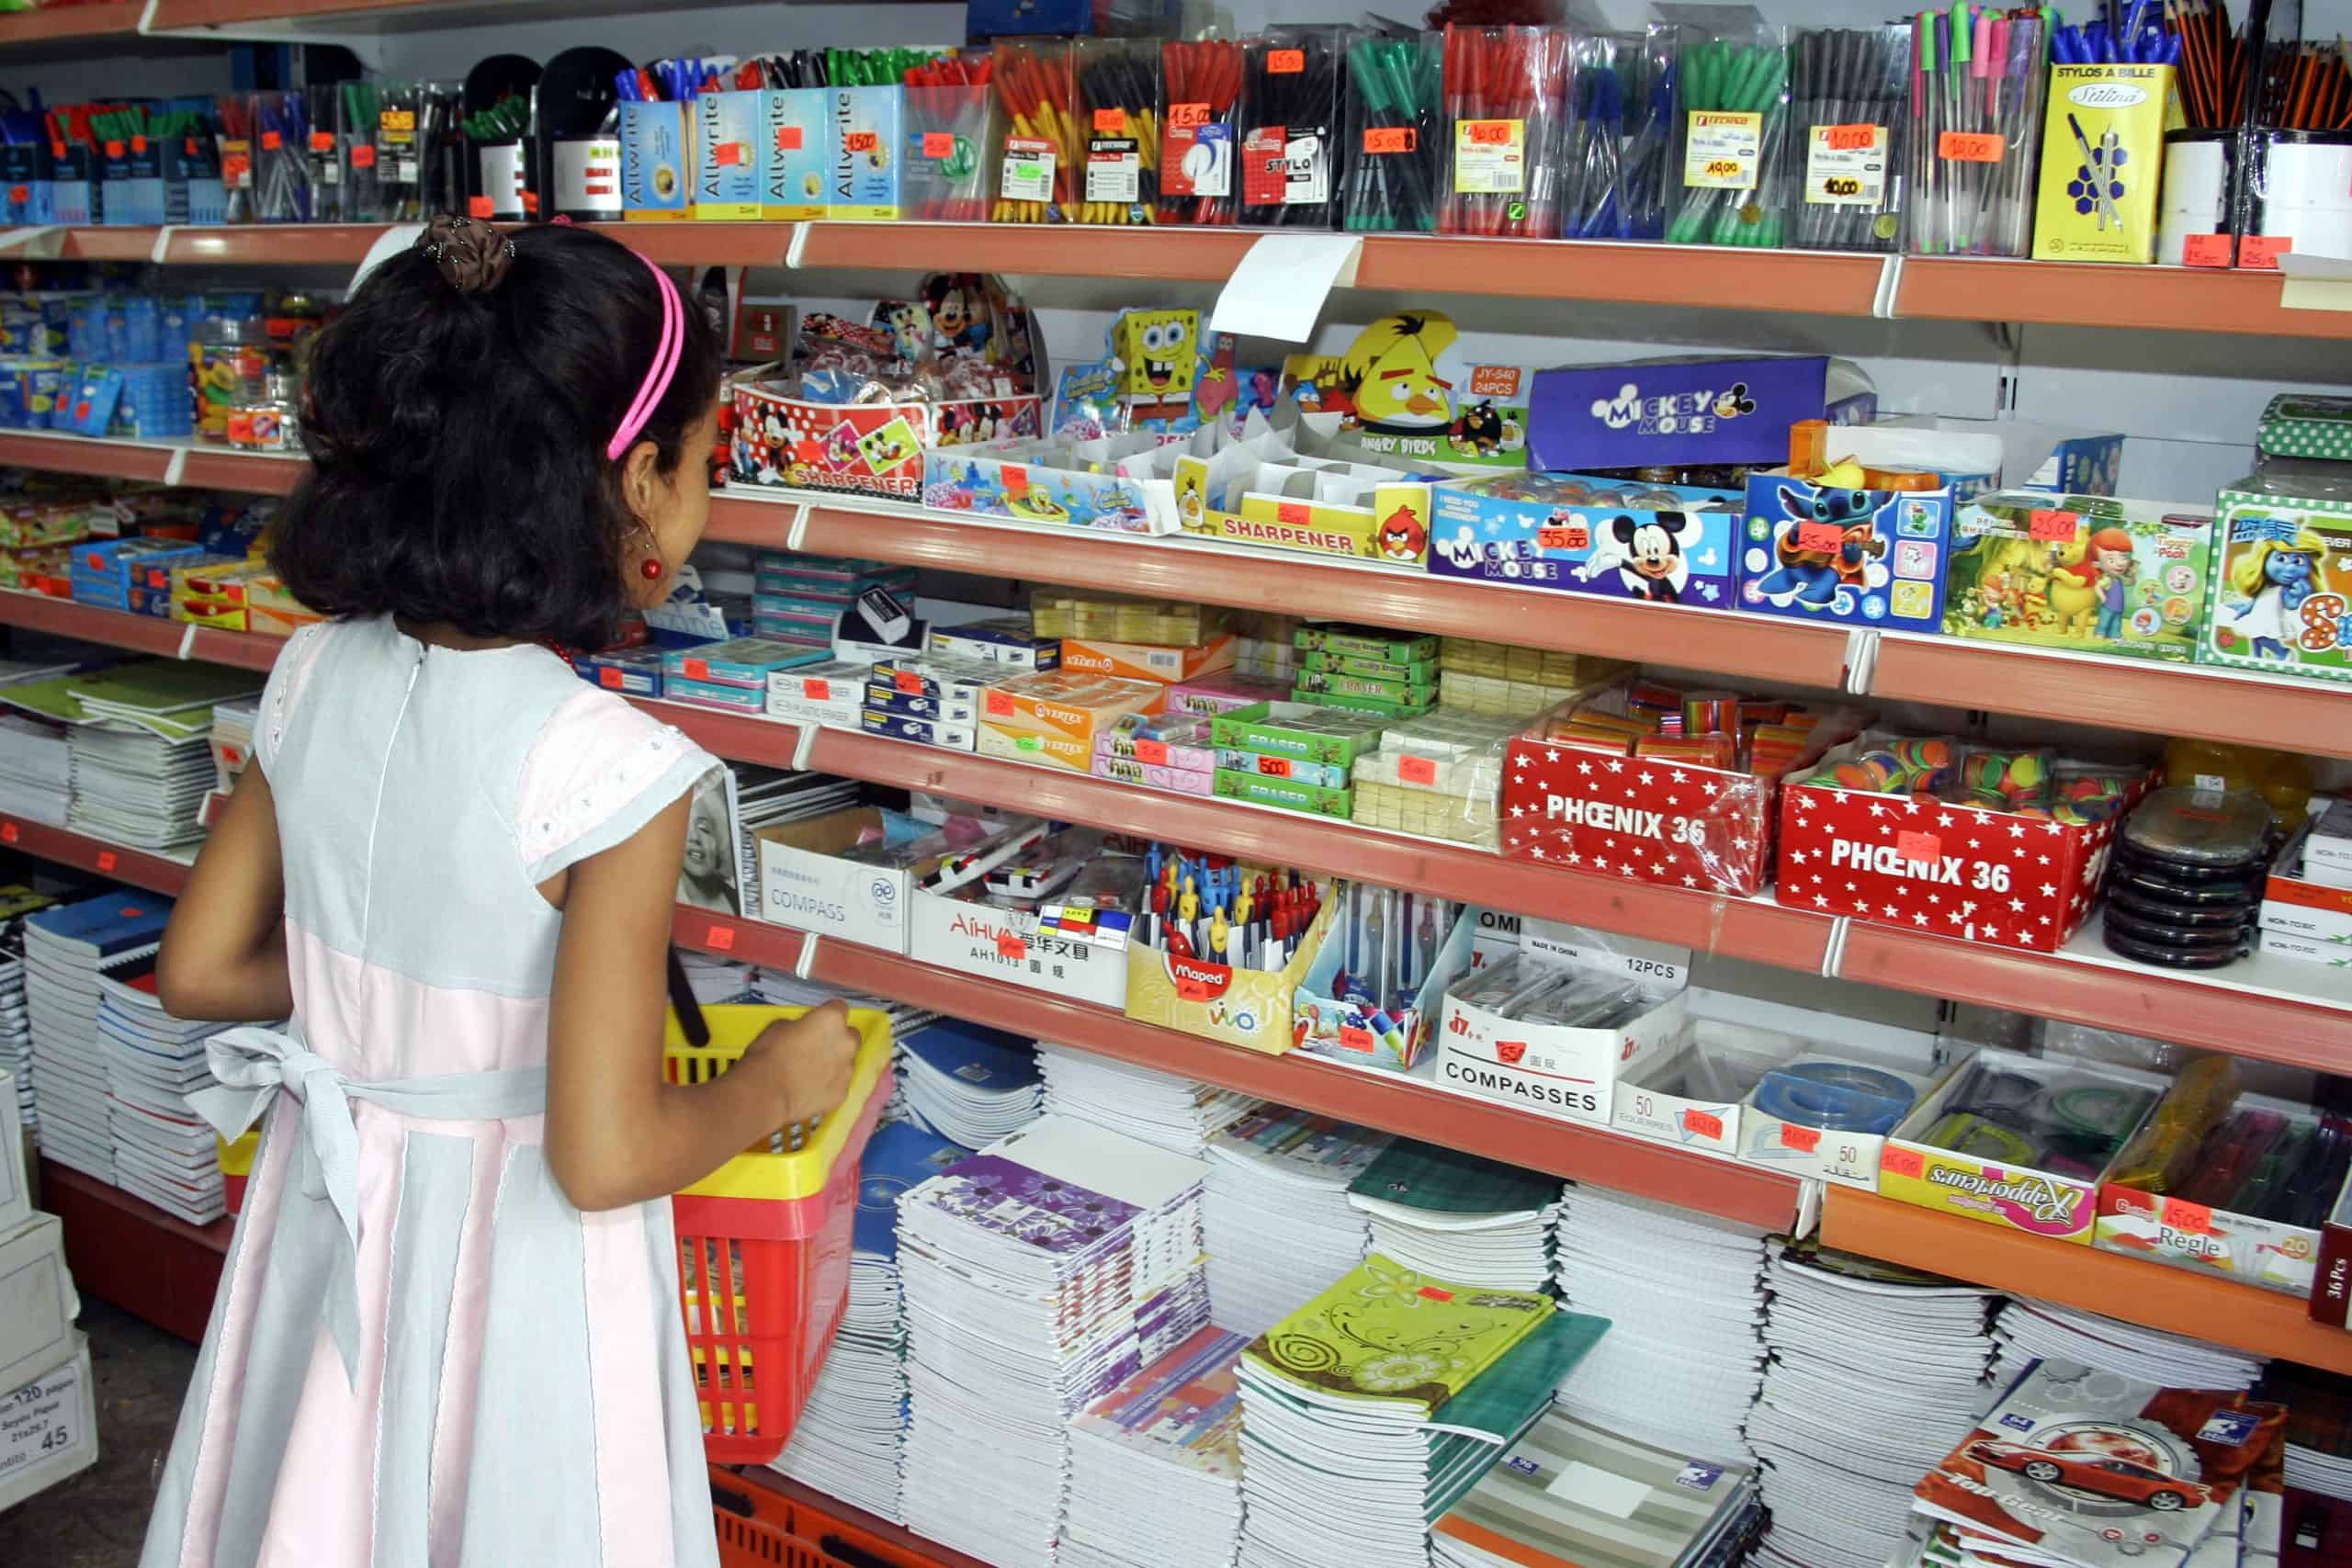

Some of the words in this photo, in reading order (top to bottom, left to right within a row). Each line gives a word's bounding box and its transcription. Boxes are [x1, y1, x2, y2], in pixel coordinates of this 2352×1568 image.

[2057, 68, 2102, 78] STYLOS
[1265, 158, 1311, 172] STYLO
[1474, 381, 1513, 394] 24PCS
[1608, 389, 1713, 423] MICKEY
[1637, 416, 1715, 434] MOUSE
[1361, 436, 1396, 452] ANGRY
[1399, 438, 1437, 457] BIRDS
[795, 468, 917, 496] SHARPENER
[1223, 517, 1354, 551] SHARPENER
[1452, 538, 1545, 563] MICKEY
[1484, 558, 1558, 581] MOUSE
[1249, 734, 1308, 753] ERASER
[1250, 784, 1308, 806] ERASER
[1545, 793, 1663, 840] PHŒNIX
[1670, 815, 1707, 846] 36
[1971, 861, 2011, 893] 36
[771, 888, 846, 922] COMPASS
[1531, 940, 1549, 951] MADE
[1558, 947, 1578, 957] CHINA
[1175, 964, 1224, 986] Maped
[1626, 958, 1675, 979] 12PCS
[1445, 1062, 1597, 1111] COMPASSES
[1635, 1094, 1654, 1117] 50
[1839, 1145, 1857, 1163] 50
[1929, 1166, 2074, 1228] Rapporteurs
[2159, 1225, 2221, 1257] Règle
[2330, 1258, 2348, 1279] Pcs
[2326, 1280, 2343, 1299] 36
[14, 1386, 41, 1406] 120
[41, 1425, 68, 1450] 45
